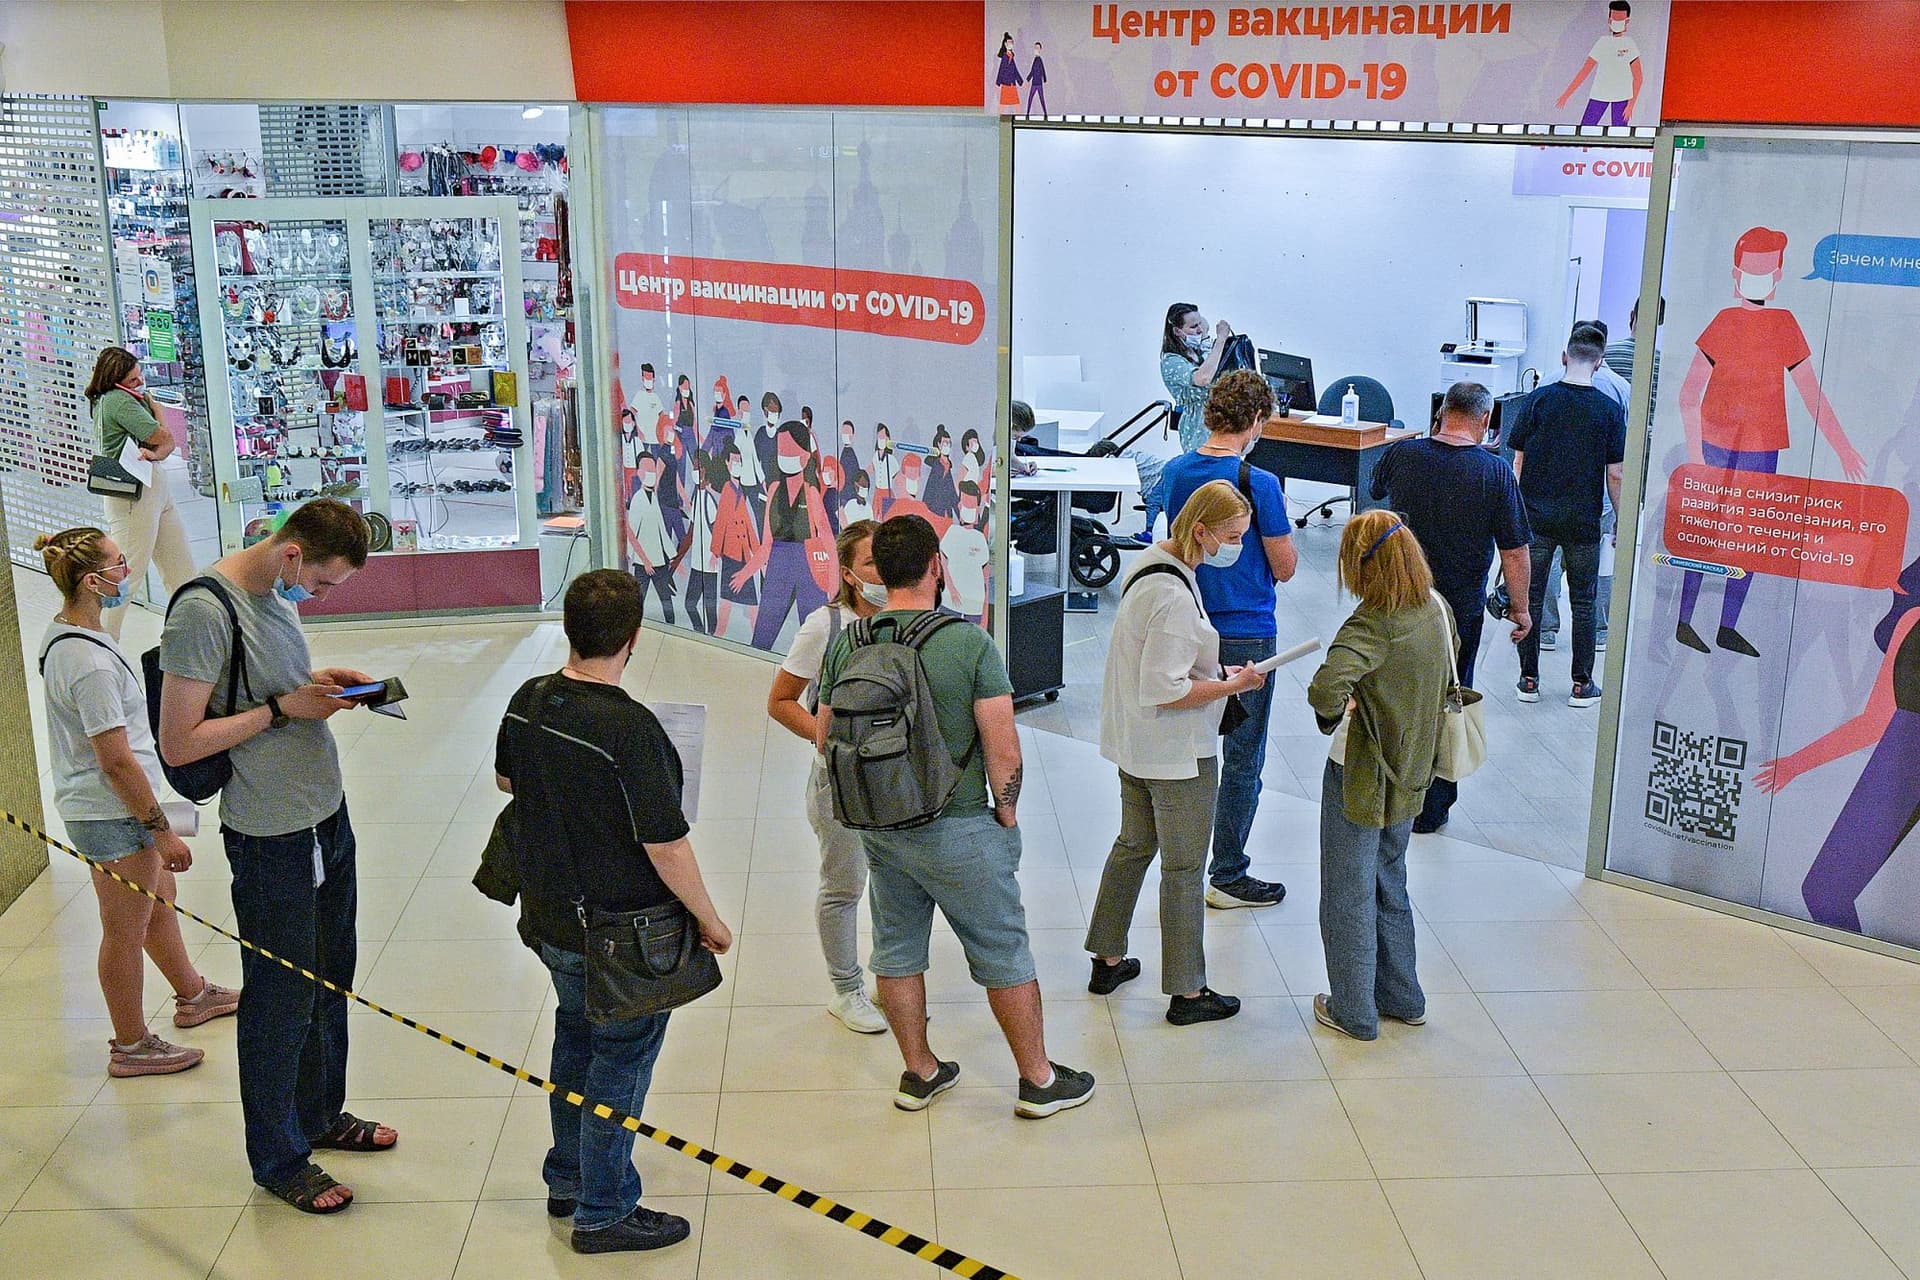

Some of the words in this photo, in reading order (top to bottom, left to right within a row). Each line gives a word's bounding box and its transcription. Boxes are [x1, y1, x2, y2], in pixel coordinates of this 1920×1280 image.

[1092, 4, 1216, 46] Центр
[1228, 3, 1511, 40] вакцинации
[1154, 70, 1199, 98] от
[1210, 62, 1408, 100] COVID-19
[1683, 138, 1697, 148] 1-9
[1562, 162, 1587, 176] от
[1829, 249, 1885, 267] Зачем
[619, 269, 686, 298] Центр
[690, 279, 825, 309] вакцинации
[831, 290, 859, 312] от
[866, 290, 975, 326] COVID-19
[1683, 477, 1742, 499] Вакцина
[1746, 489, 1800, 505] снизит
[1803, 495, 1843, 511] риск
[1680, 514, 1743, 534] тяжелого
[1747, 525, 1809, 542] течения
[1814, 534, 1824, 545] и
[1681, 496, 1744, 516] развития
[1749, 506, 1855, 532] заболевания,
[1858, 521, 1887, 534] его
[1677, 531, 1767, 554] осложнений
[1770, 545, 1787, 559] от
[1790, 547, 1855, 567] Covid-19
